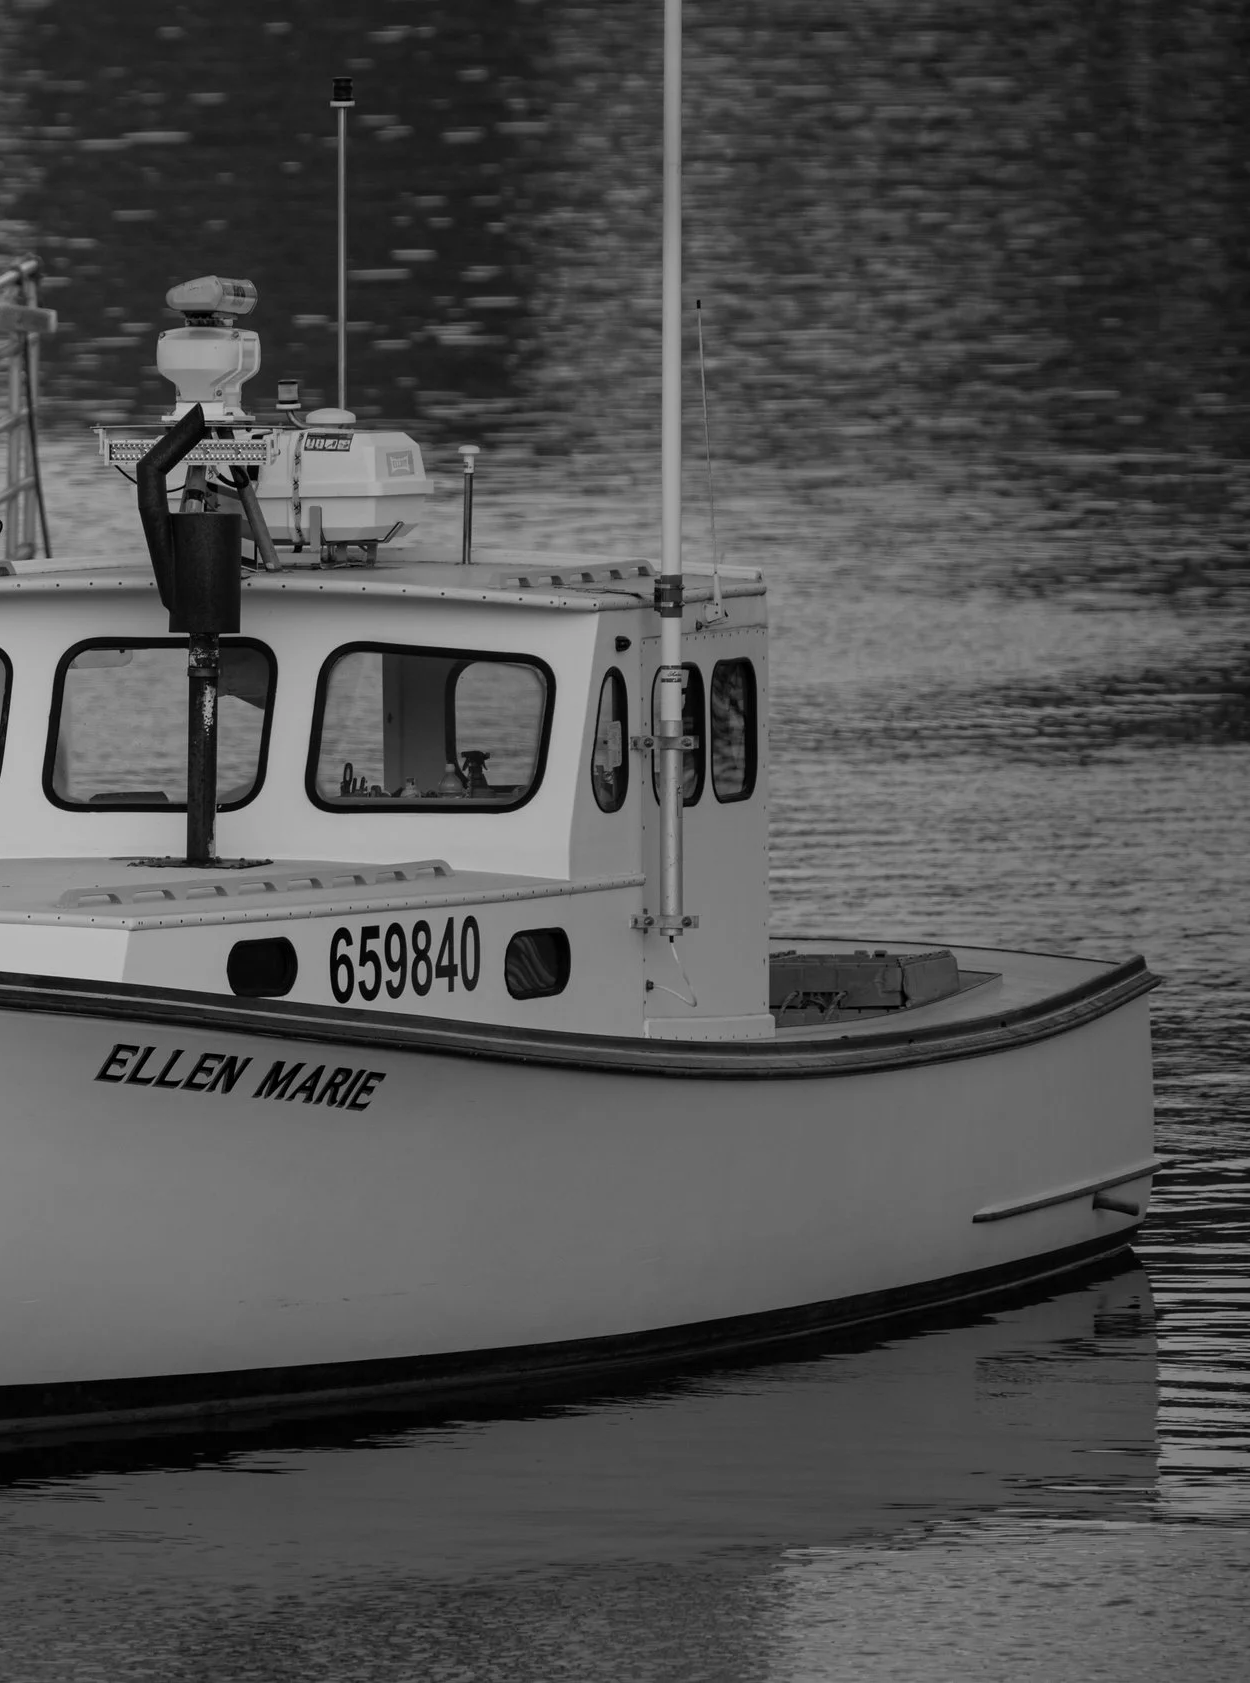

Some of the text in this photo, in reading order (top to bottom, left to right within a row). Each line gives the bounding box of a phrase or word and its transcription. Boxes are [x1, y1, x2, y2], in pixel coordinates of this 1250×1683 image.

[329, 915, 481, 1004] 659840
[94, 1043, 387, 1112] ELLEN MARIE
